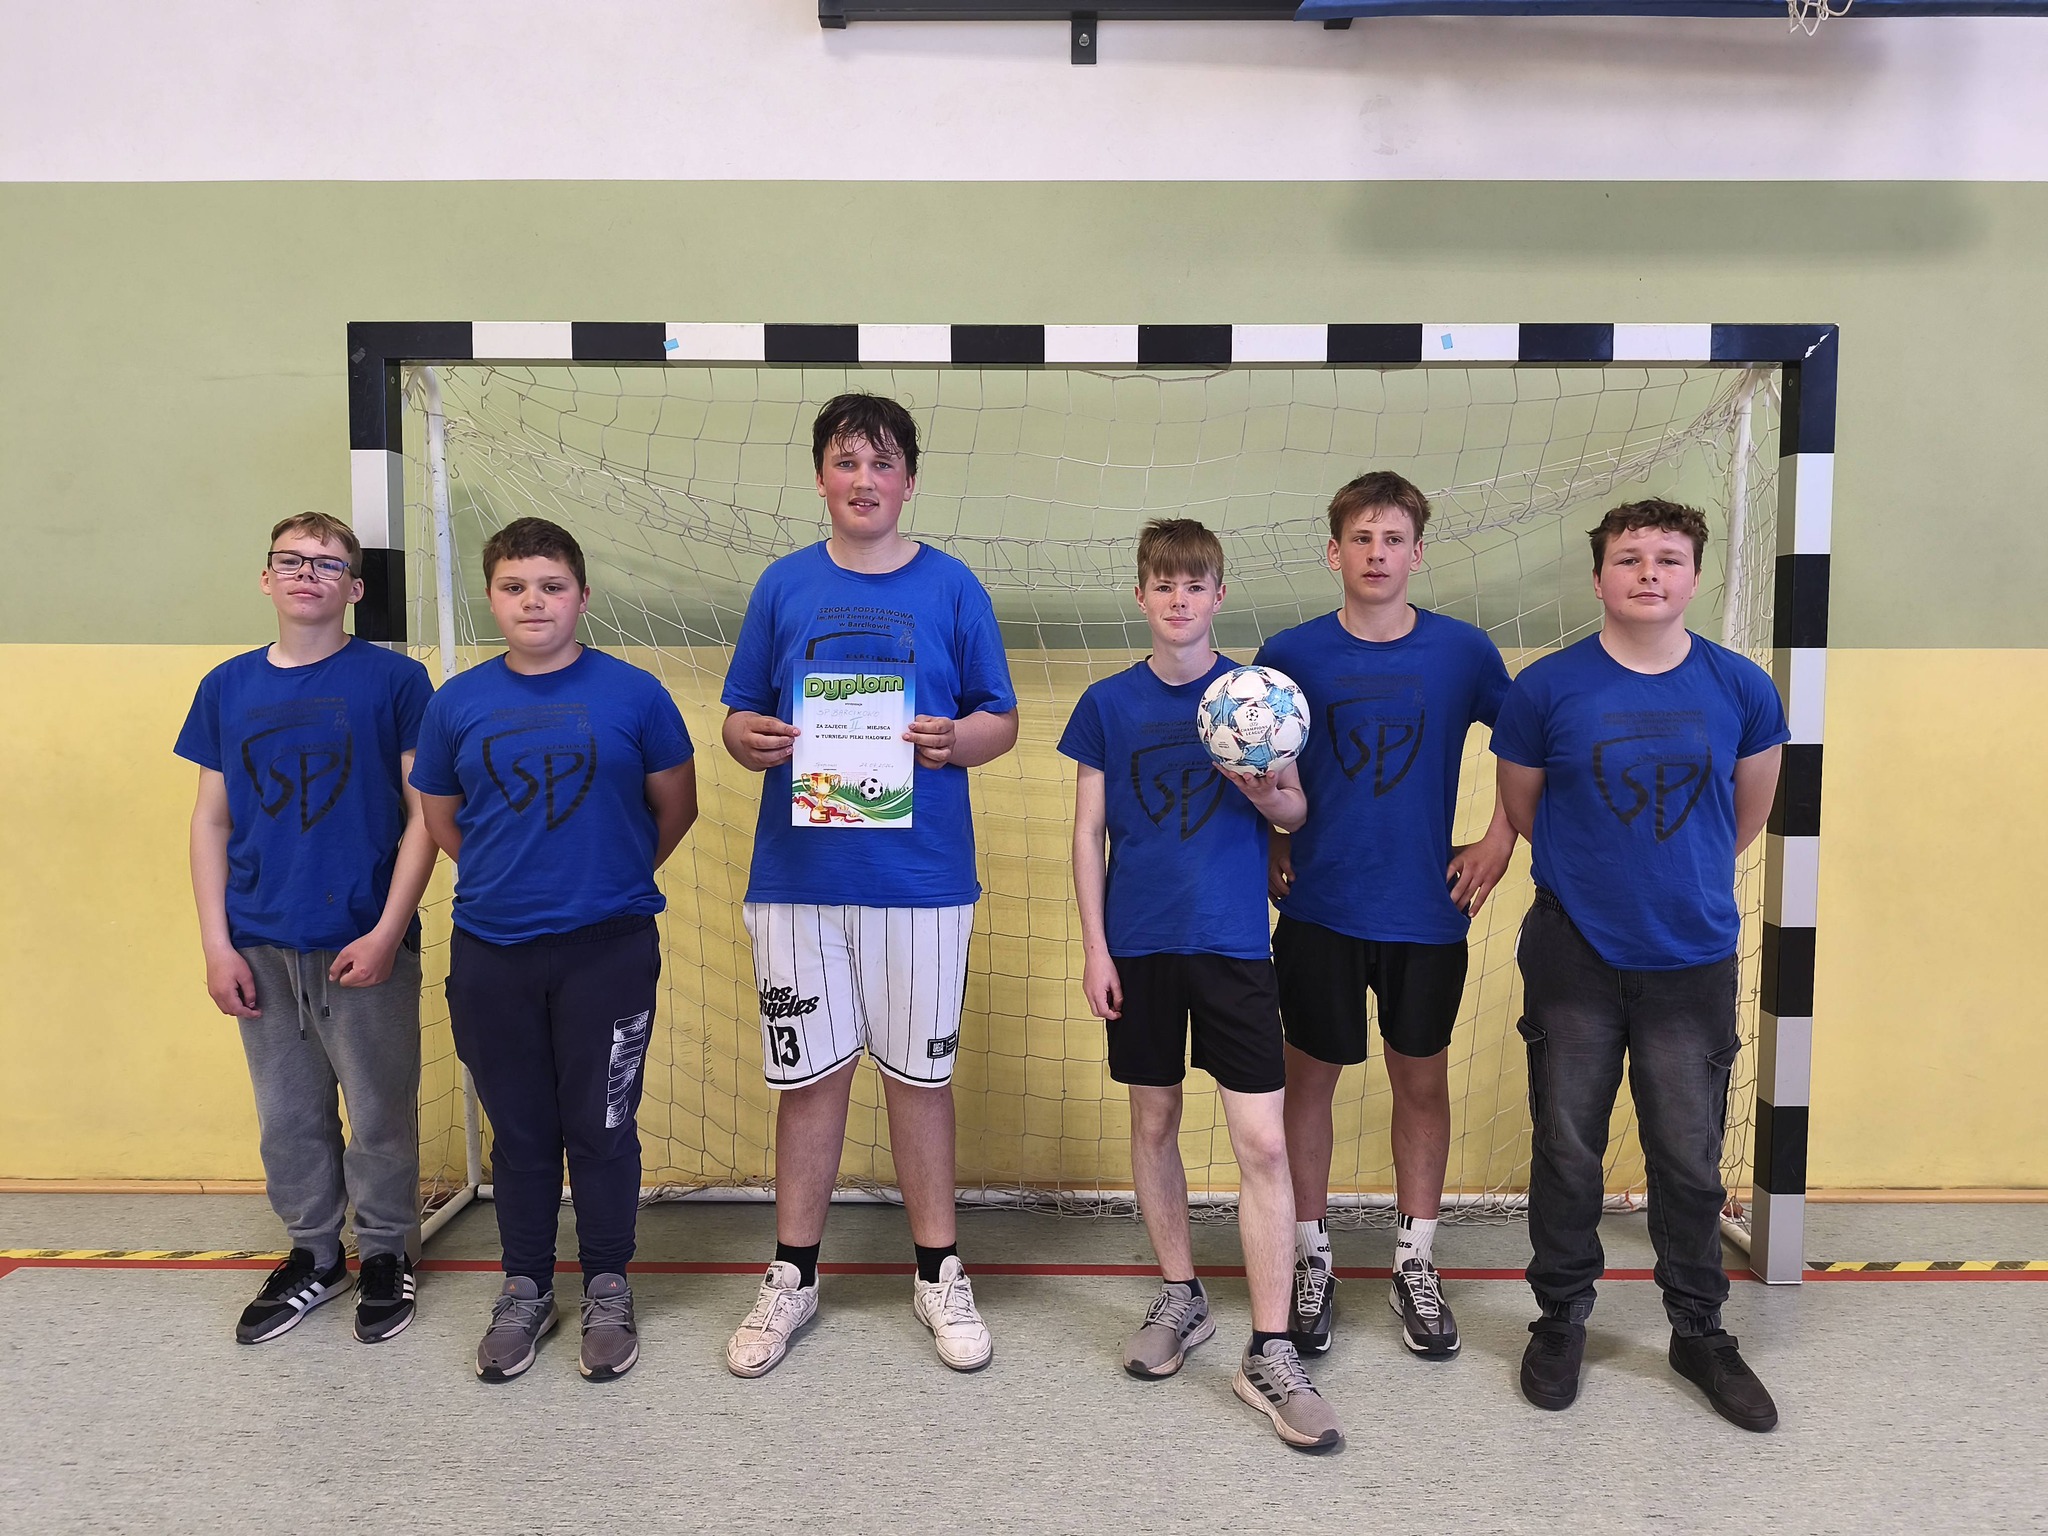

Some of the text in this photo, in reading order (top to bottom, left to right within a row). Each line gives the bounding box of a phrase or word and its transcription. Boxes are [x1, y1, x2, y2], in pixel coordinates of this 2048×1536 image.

[853, 607, 913, 619] PODSTAWOWA
[804, 674, 904, 701] Dyplom
[764, 978, 793, 1002] Los
[767, 1024, 801, 1068] 13
